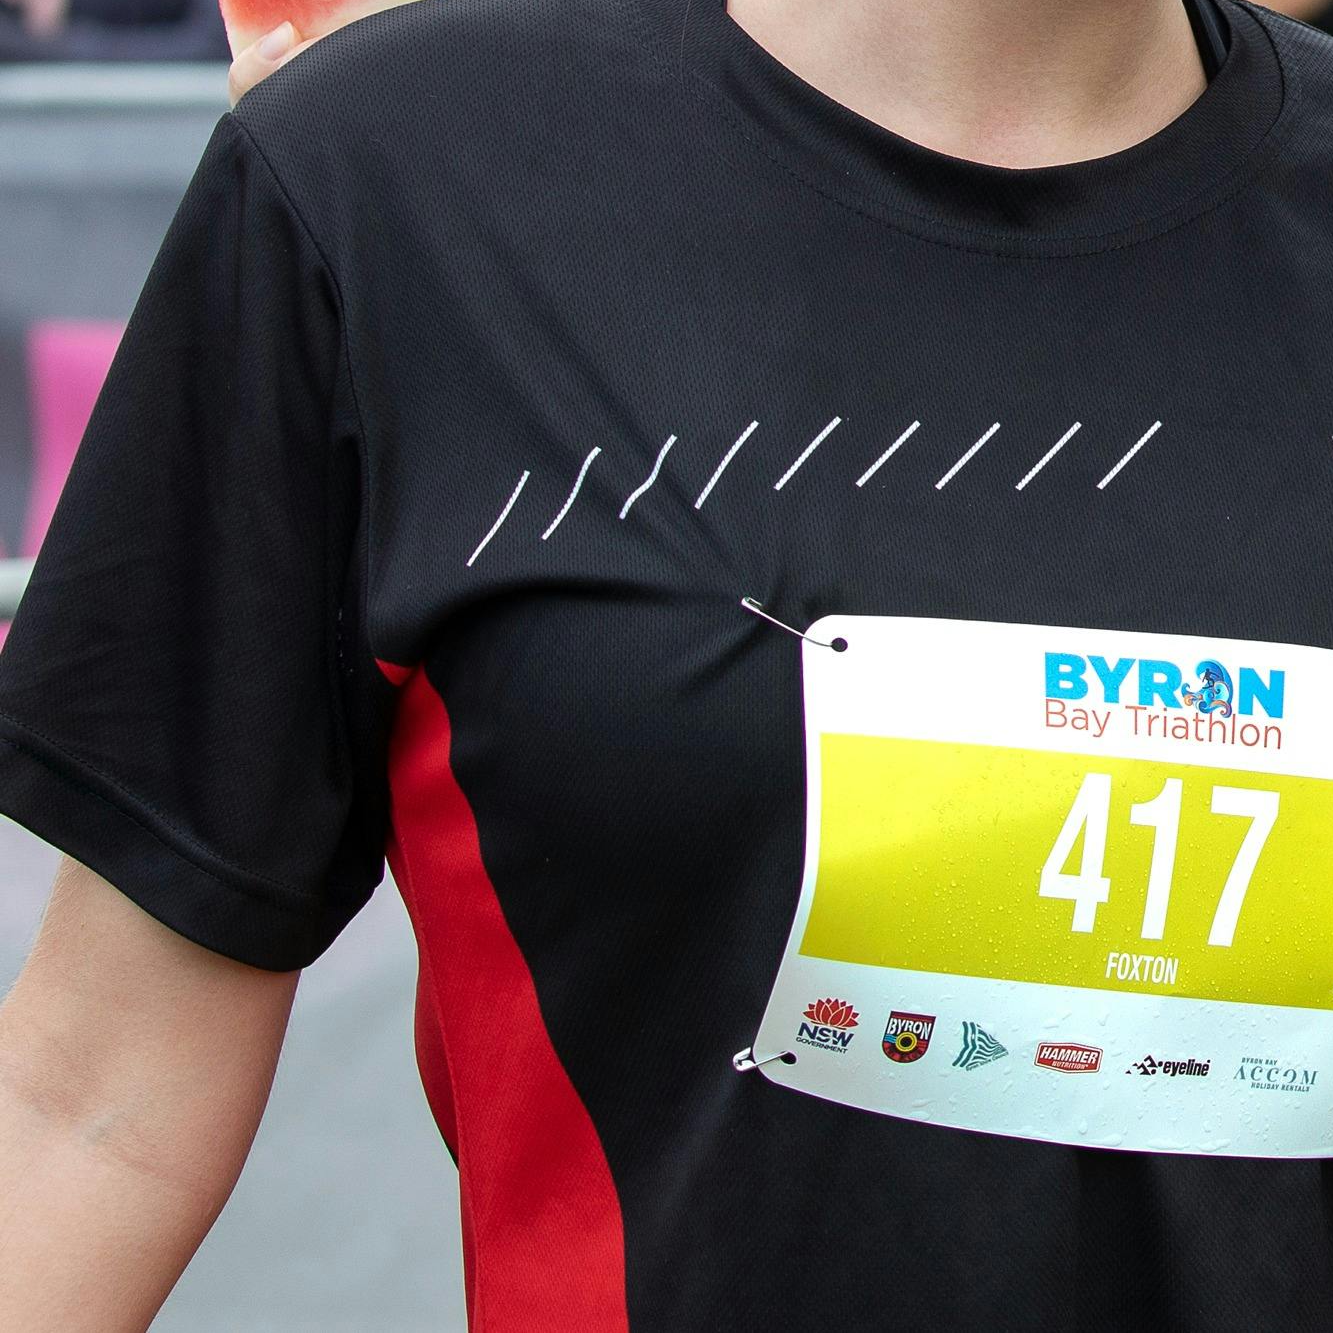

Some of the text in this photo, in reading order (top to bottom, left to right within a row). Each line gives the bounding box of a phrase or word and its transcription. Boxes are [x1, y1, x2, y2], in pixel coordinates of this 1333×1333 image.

[1045, 699, 1282, 750] Bay Triathlon
[1039, 770, 1281, 949] 417
[1105, 951, 1179, 986] FOXTON
[798, 1022, 855, 1048] NSW
[887, 1017, 932, 1040] BYRON
[795, 1037, 848, 1054] GOVERNMENT
[1040, 1046, 1099, 1064] HAMMER
[1250, 1082, 1311, 1092] HOLIDAY RENTALS
